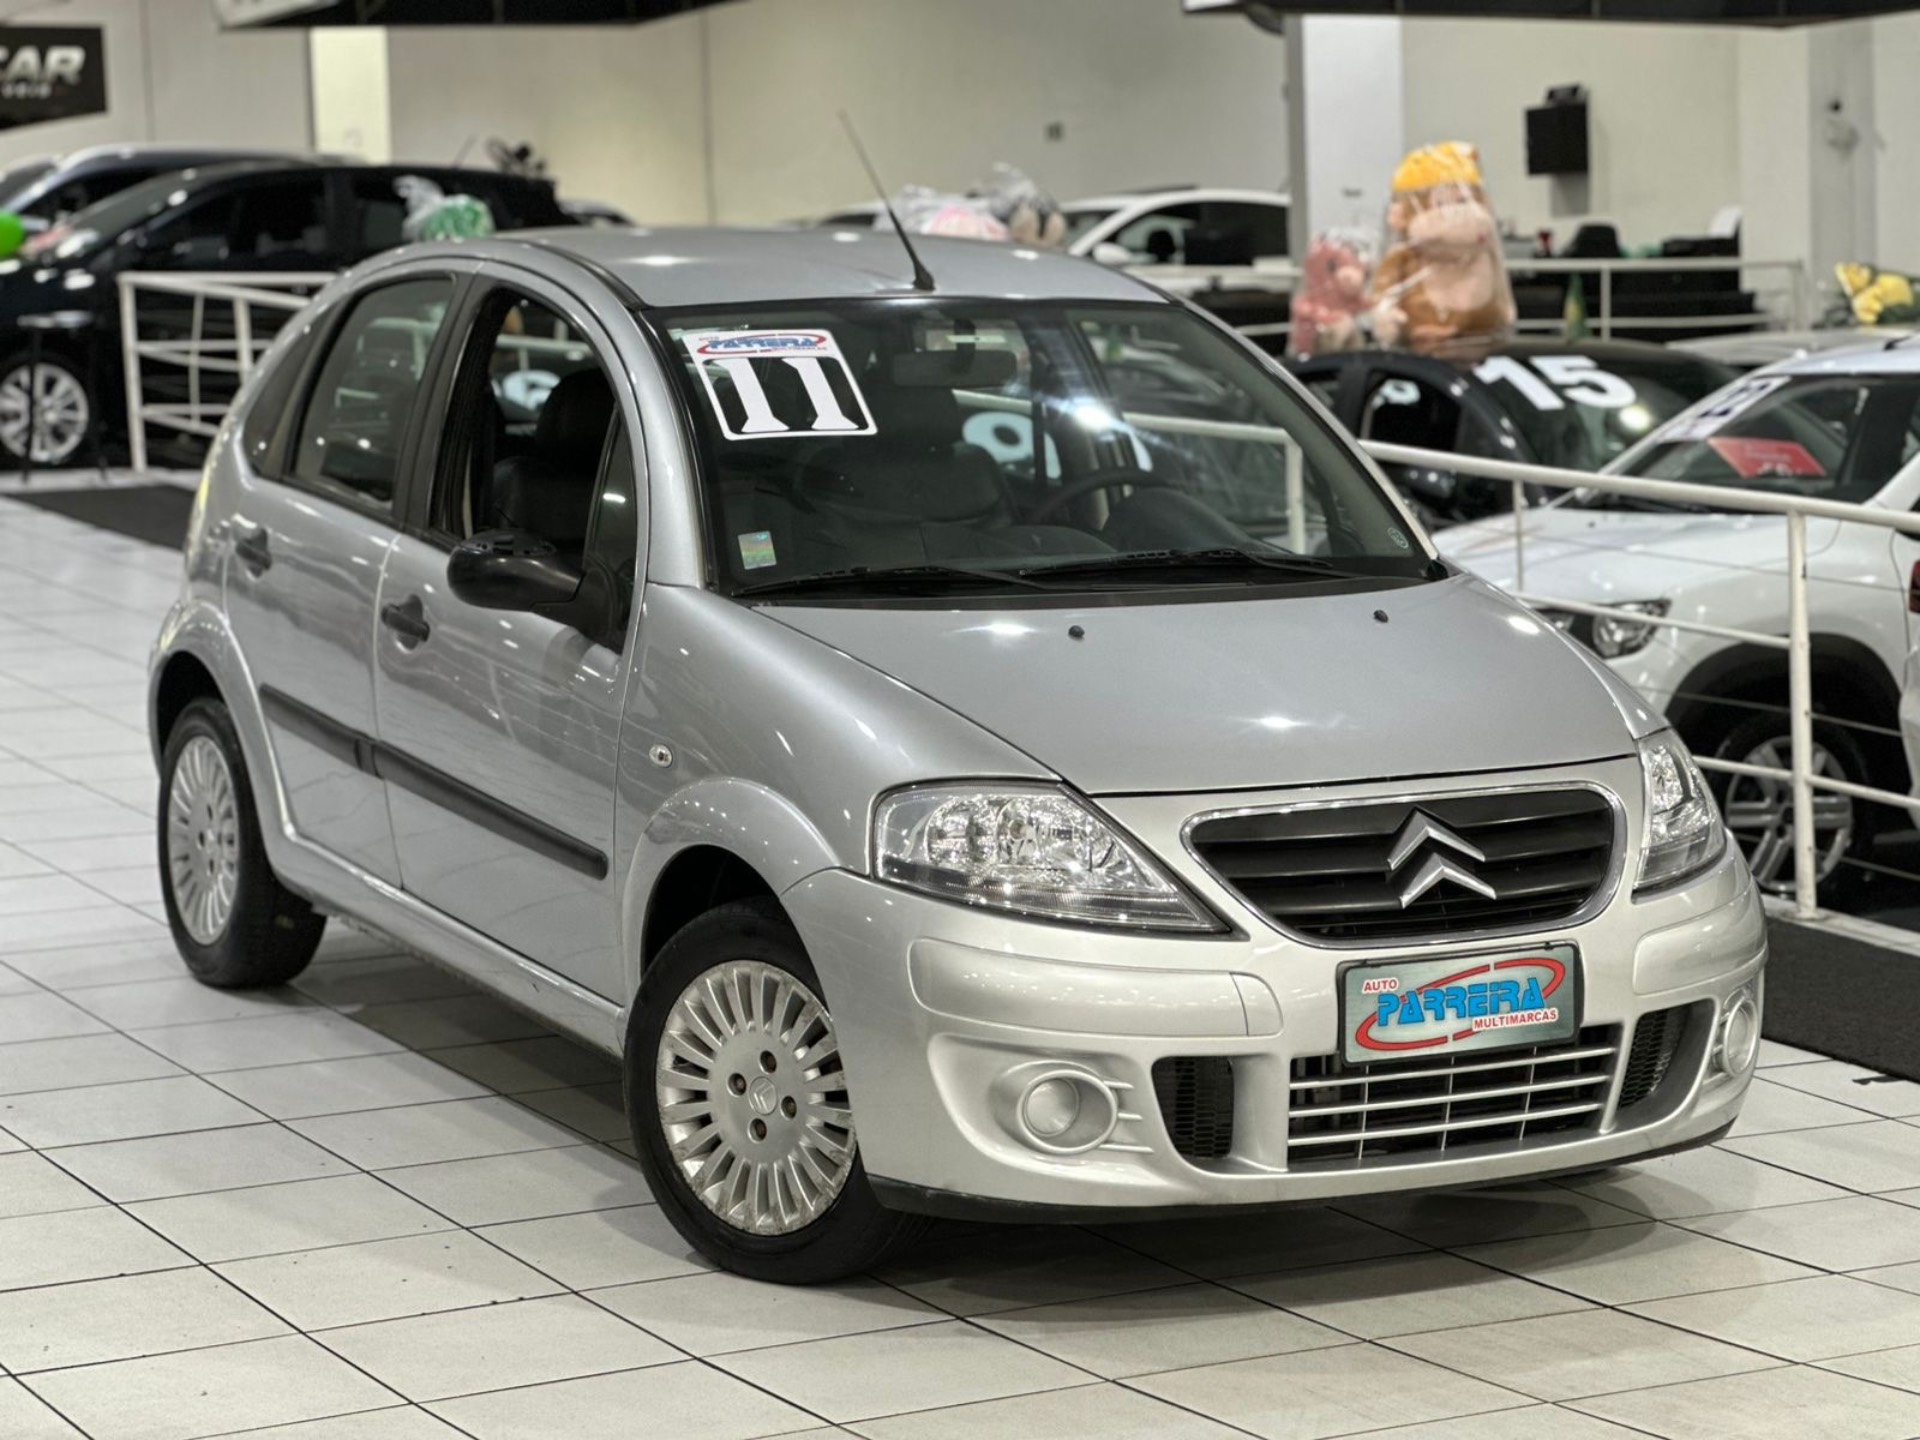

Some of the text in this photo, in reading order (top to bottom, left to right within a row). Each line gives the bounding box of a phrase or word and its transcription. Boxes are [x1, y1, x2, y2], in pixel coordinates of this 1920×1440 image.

[713, 357, 859, 432] 11
[1472, 354, 1637, 410] 15
[1364, 979, 1398, 992] AUTO
[1377, 976, 1545, 1027] PARREIRA
[1474, 1010, 1557, 1029] MULTIMARCAS
